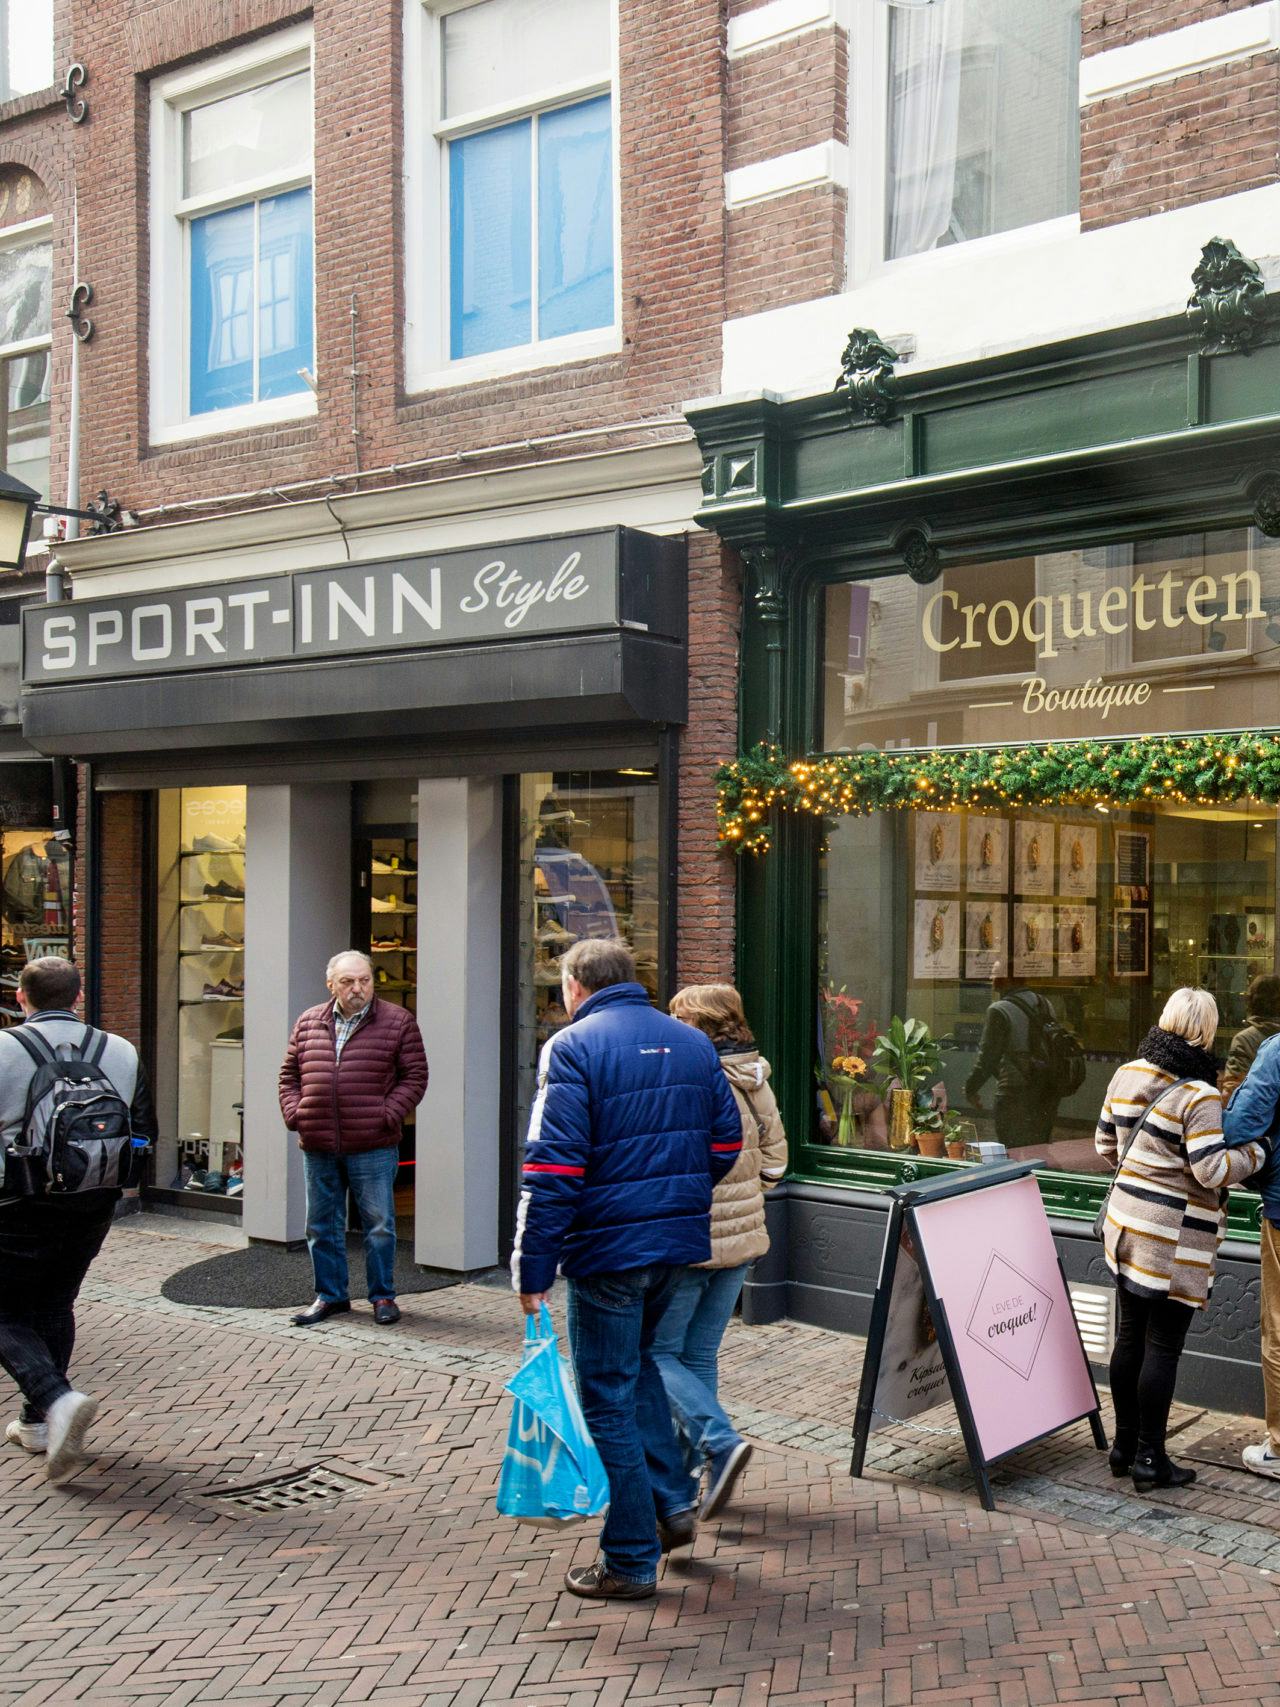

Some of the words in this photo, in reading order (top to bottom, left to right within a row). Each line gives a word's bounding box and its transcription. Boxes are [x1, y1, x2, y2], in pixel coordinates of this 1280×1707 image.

[42, 567, 442, 670] SPORT-INN
[460, 551, 590, 629] Style
[922, 568, 1267, 659] Croquetten
[1021, 677, 1152, 720] Boutique
[987, 1302, 1037, 1338] croquet!
[991, 1299, 1013, 1315] LEVE
[1011, 1295, 1025, 1308] DE
